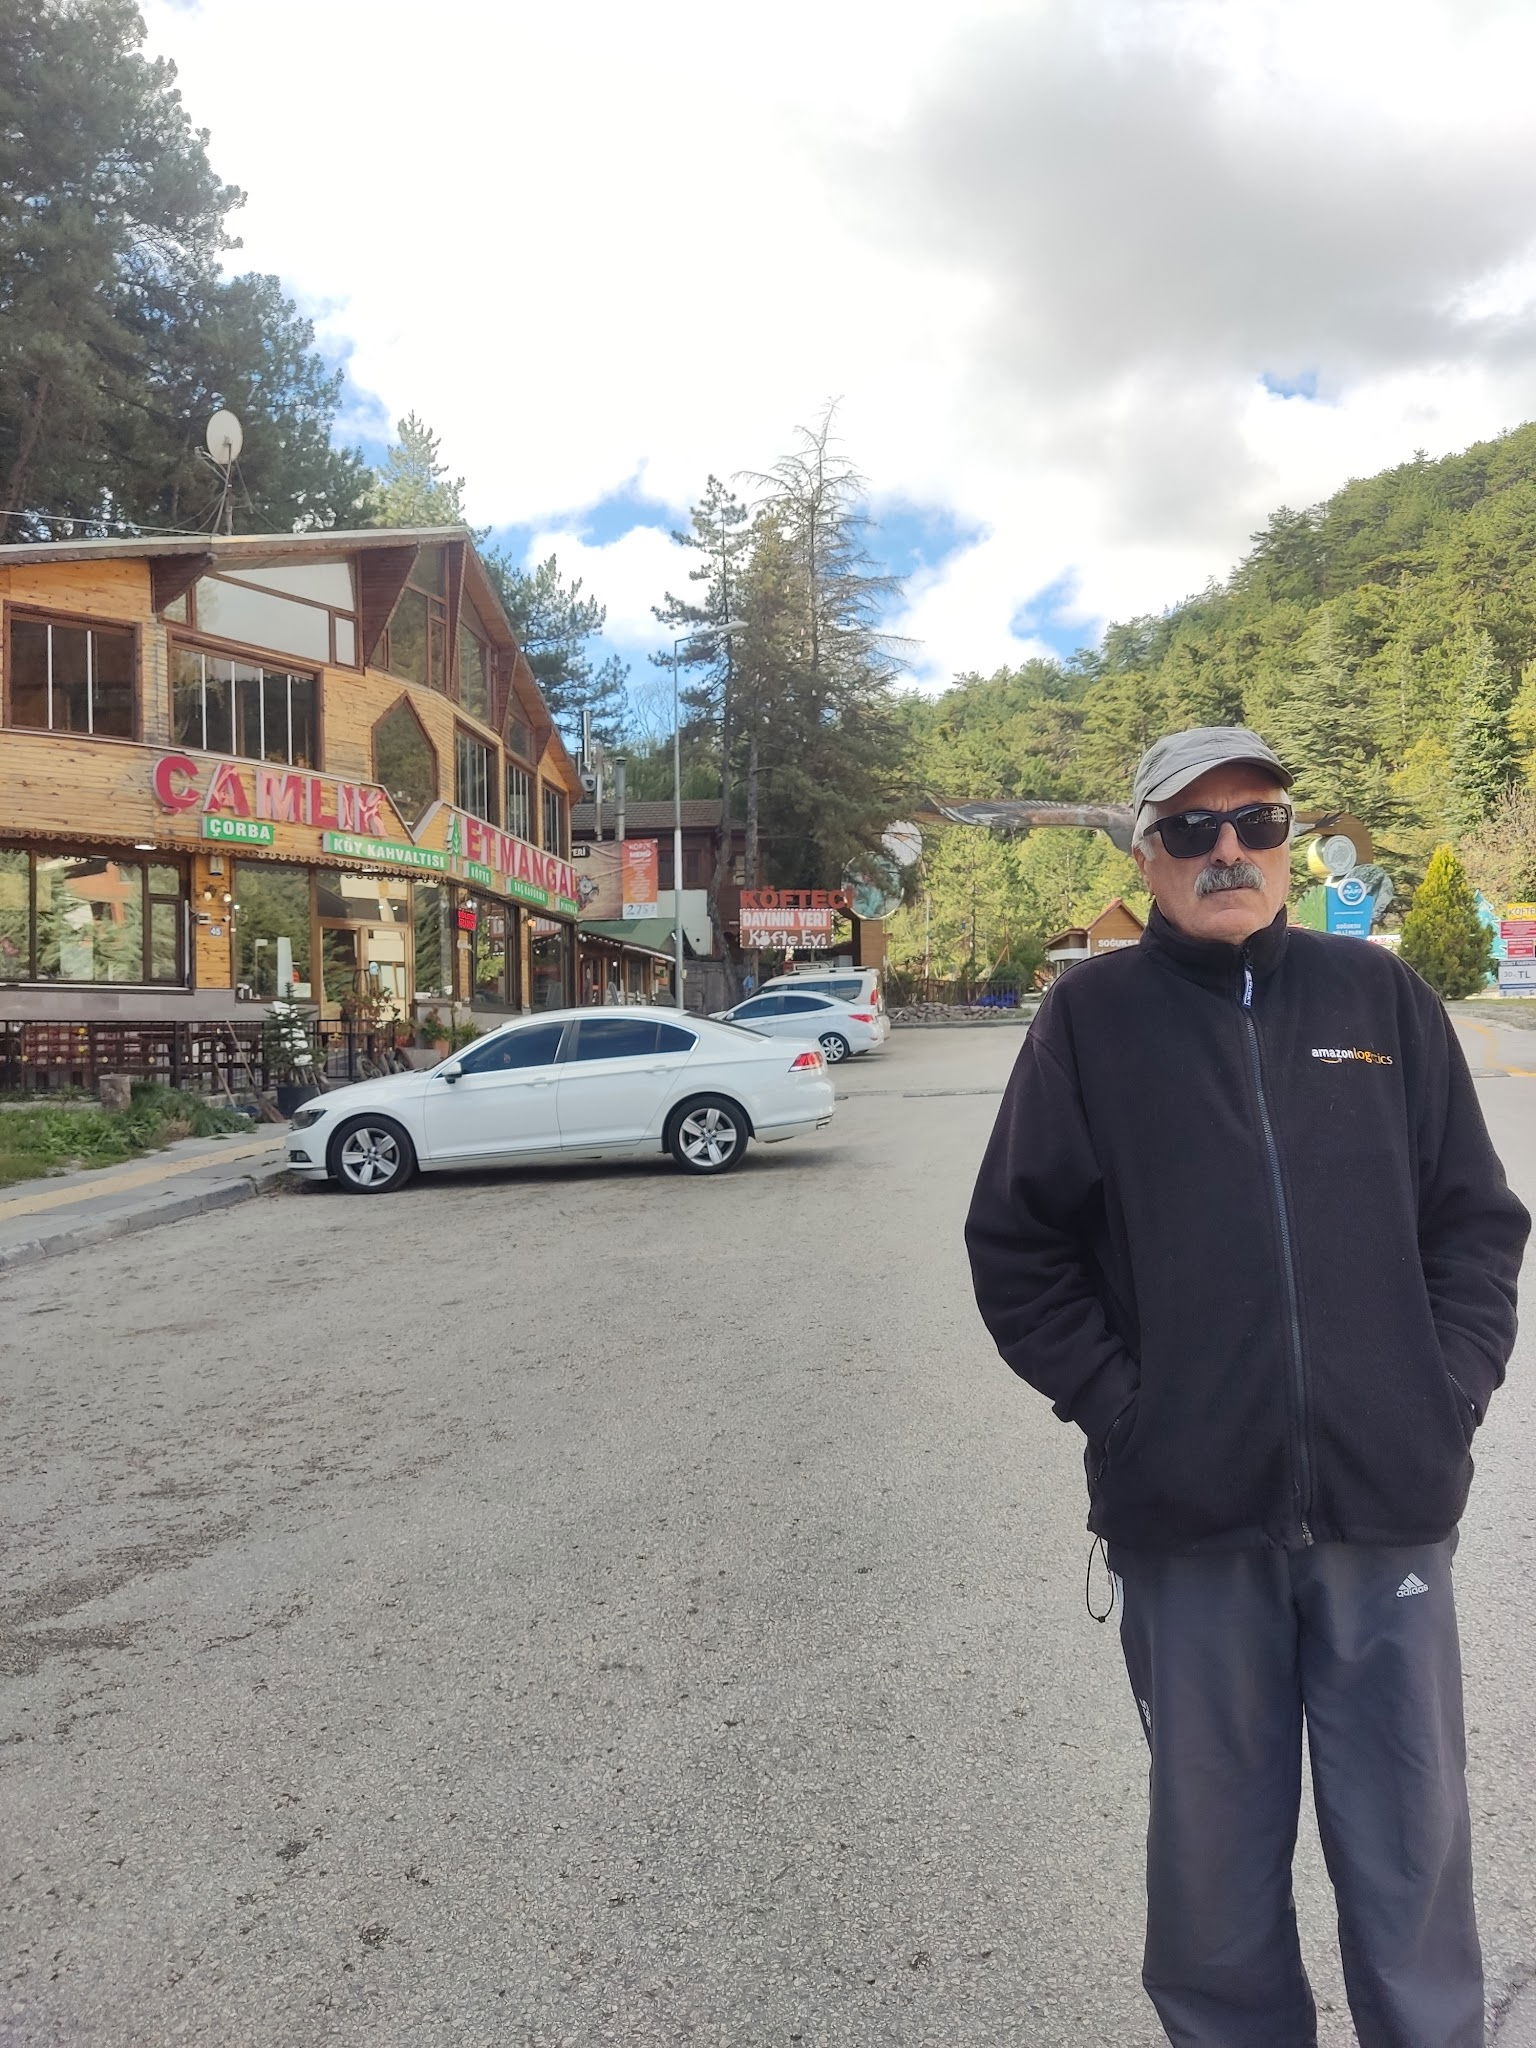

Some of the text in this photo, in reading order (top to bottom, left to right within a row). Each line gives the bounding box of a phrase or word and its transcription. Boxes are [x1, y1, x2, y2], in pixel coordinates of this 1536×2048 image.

[153, 755, 388, 836] ÇAMLIK
[209, 818, 271, 840] ÇORBA
[333, 837, 445, 868] KÖY KAHVALTISI
[461, 816, 496, 866] ET
[495, 833, 579, 901] MANGAL
[572, 847, 586, 857] ERİ
[748, 929, 827, 946] Köfte Evi
[1518, 971, 1531, 979] TL
[1396, 1584, 1429, 1598] adidas
